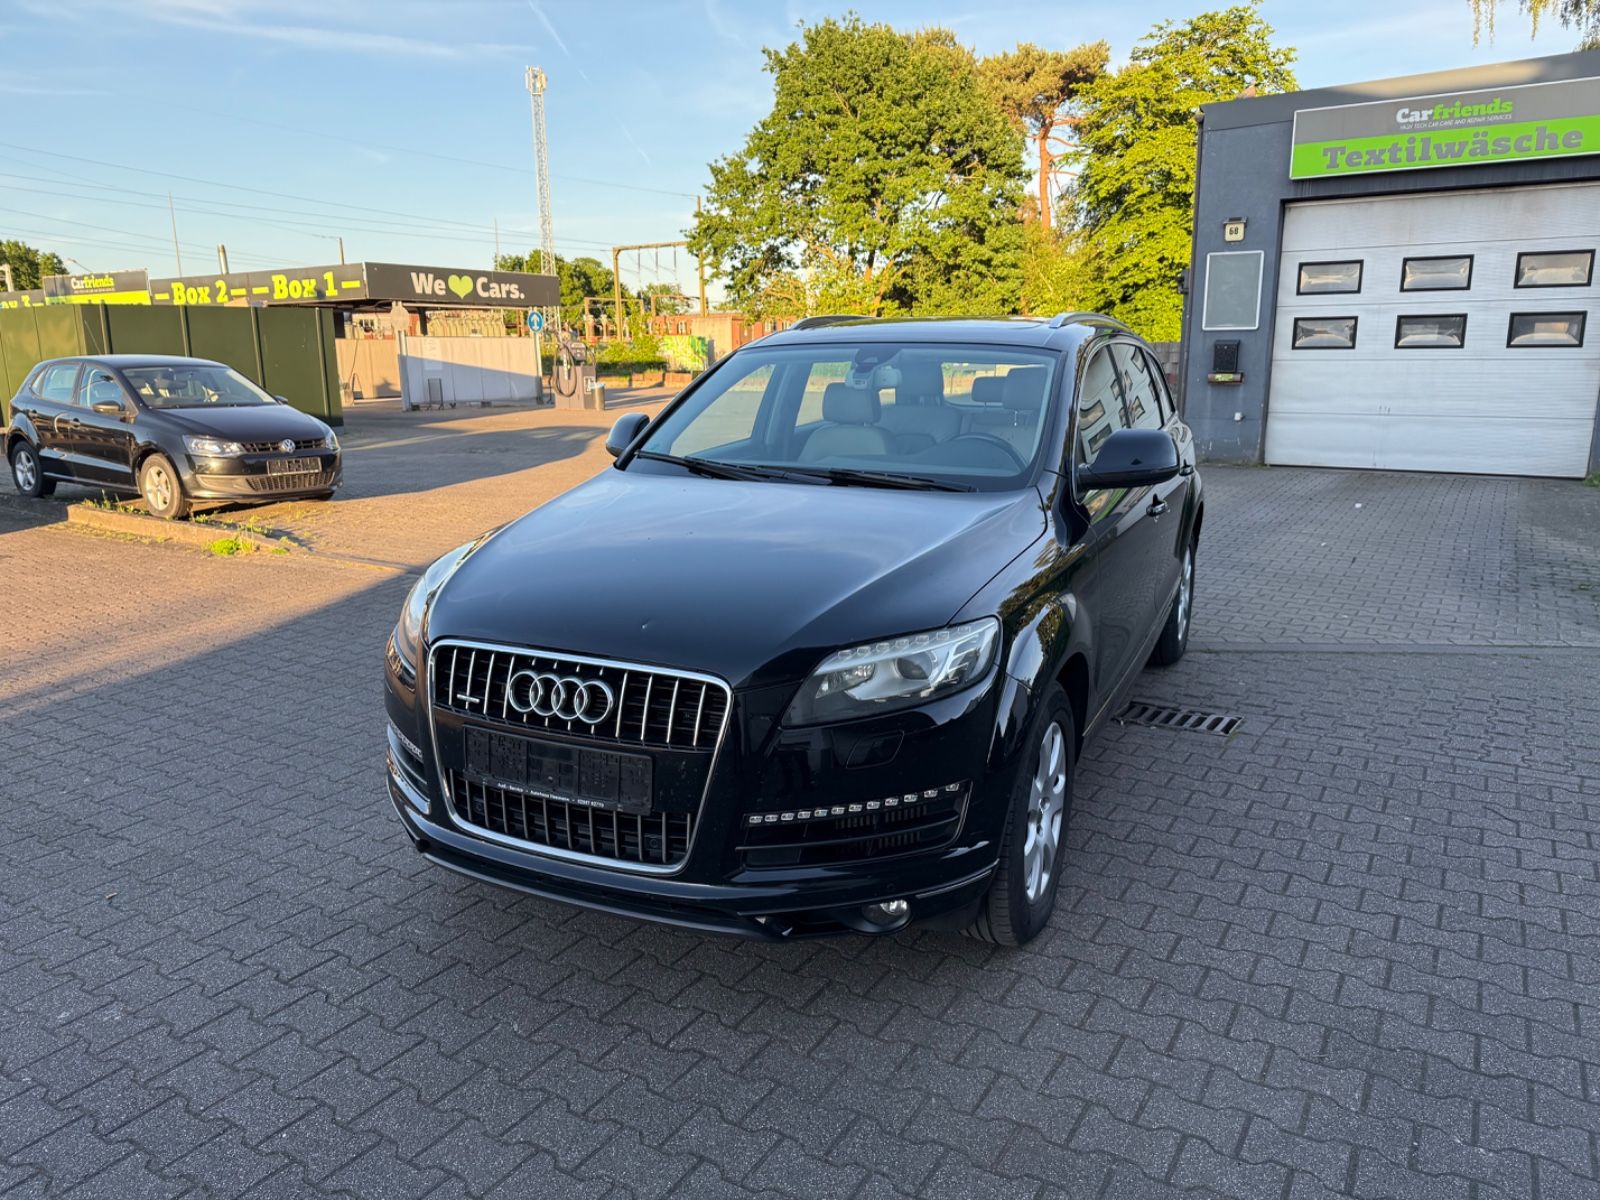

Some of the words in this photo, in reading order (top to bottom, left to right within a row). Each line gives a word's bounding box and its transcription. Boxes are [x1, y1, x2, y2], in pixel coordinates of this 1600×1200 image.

[1396, 97, 1513, 123] Carfriends
[1322, 126, 1584, 169] Textilwäsche
[71, 274, 115, 290] Carfriends
[171, 281, 212, 306] Box
[215, 279, 229, 304] 2
[271, 274, 317, 300] Box
[323, 271, 338, 297] 1
[410, 272, 446, 296] We
[475, 276, 525, 299] Cars.
